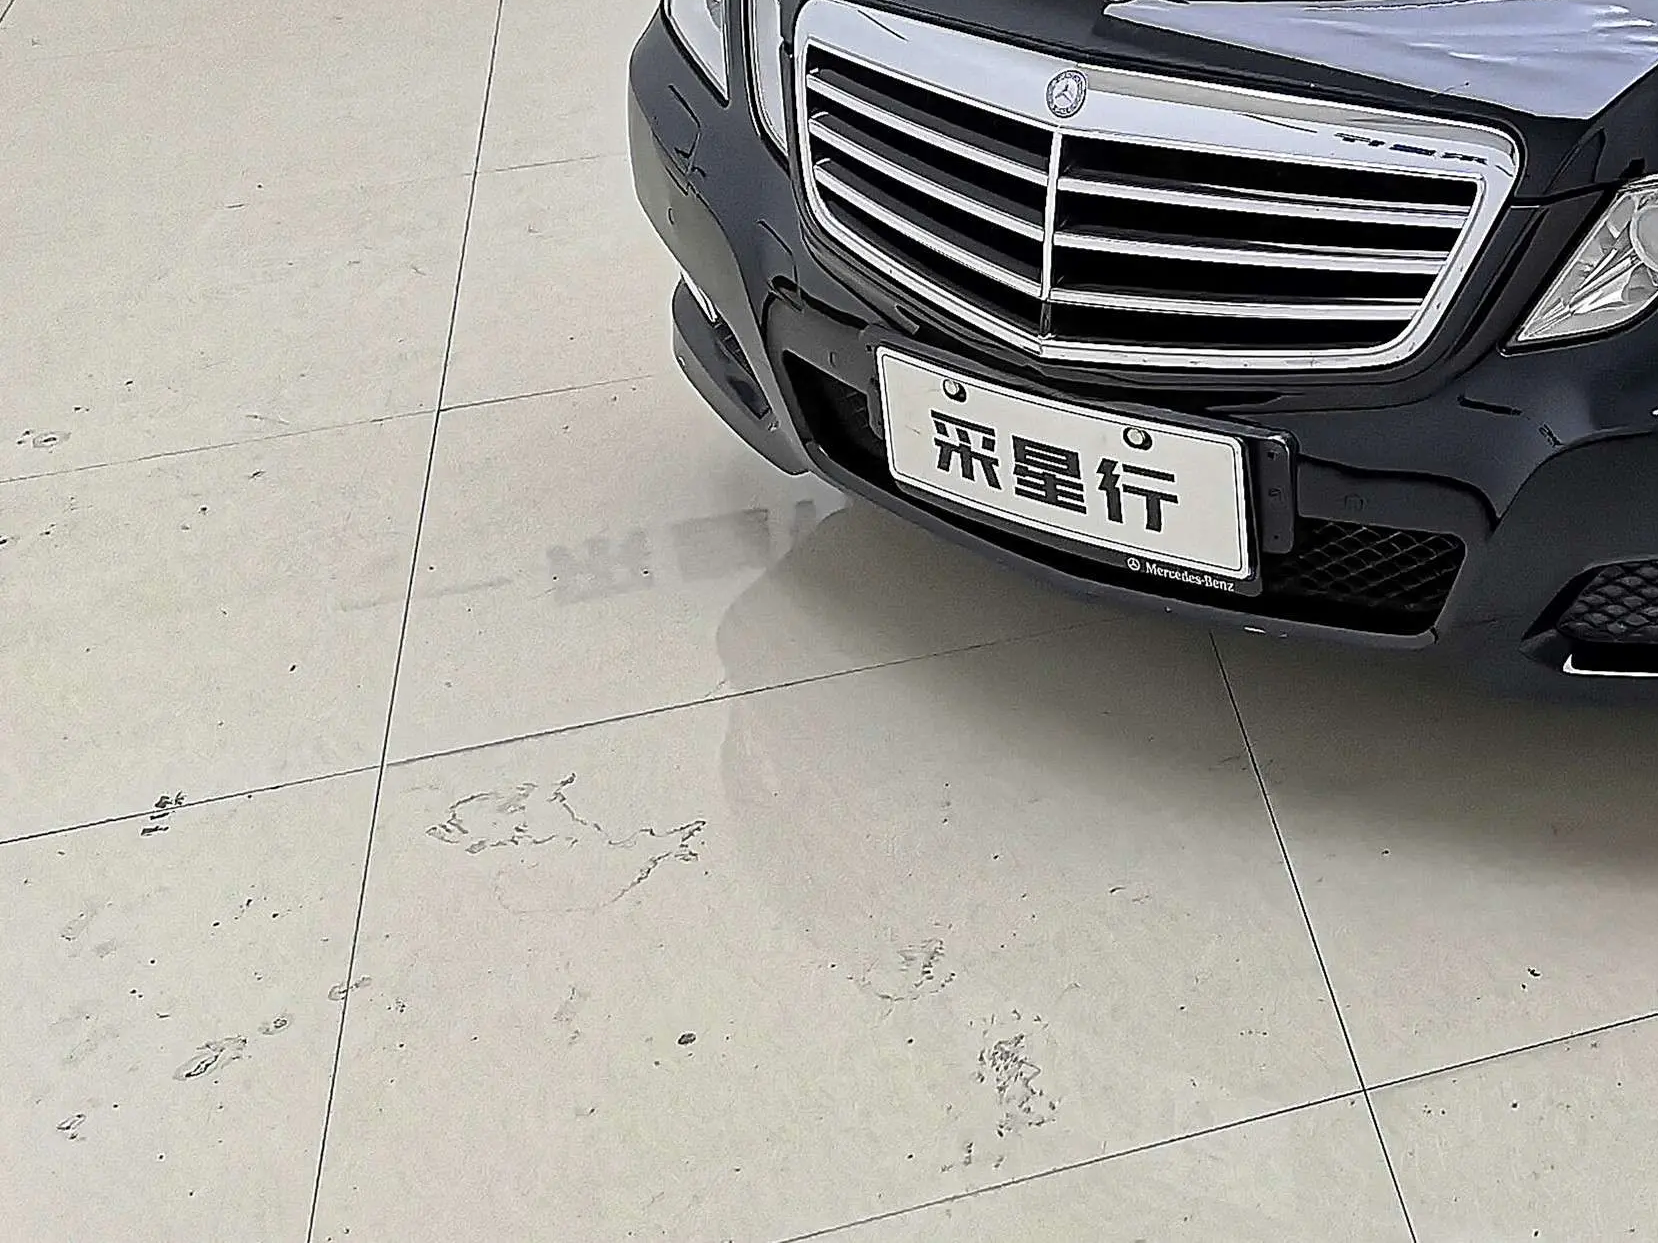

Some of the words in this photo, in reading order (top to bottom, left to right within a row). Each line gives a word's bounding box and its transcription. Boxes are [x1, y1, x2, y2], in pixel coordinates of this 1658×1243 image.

[929, 409, 1179, 534] 采星行
[1145, 561, 1235, 592] Mercedes-Benz
